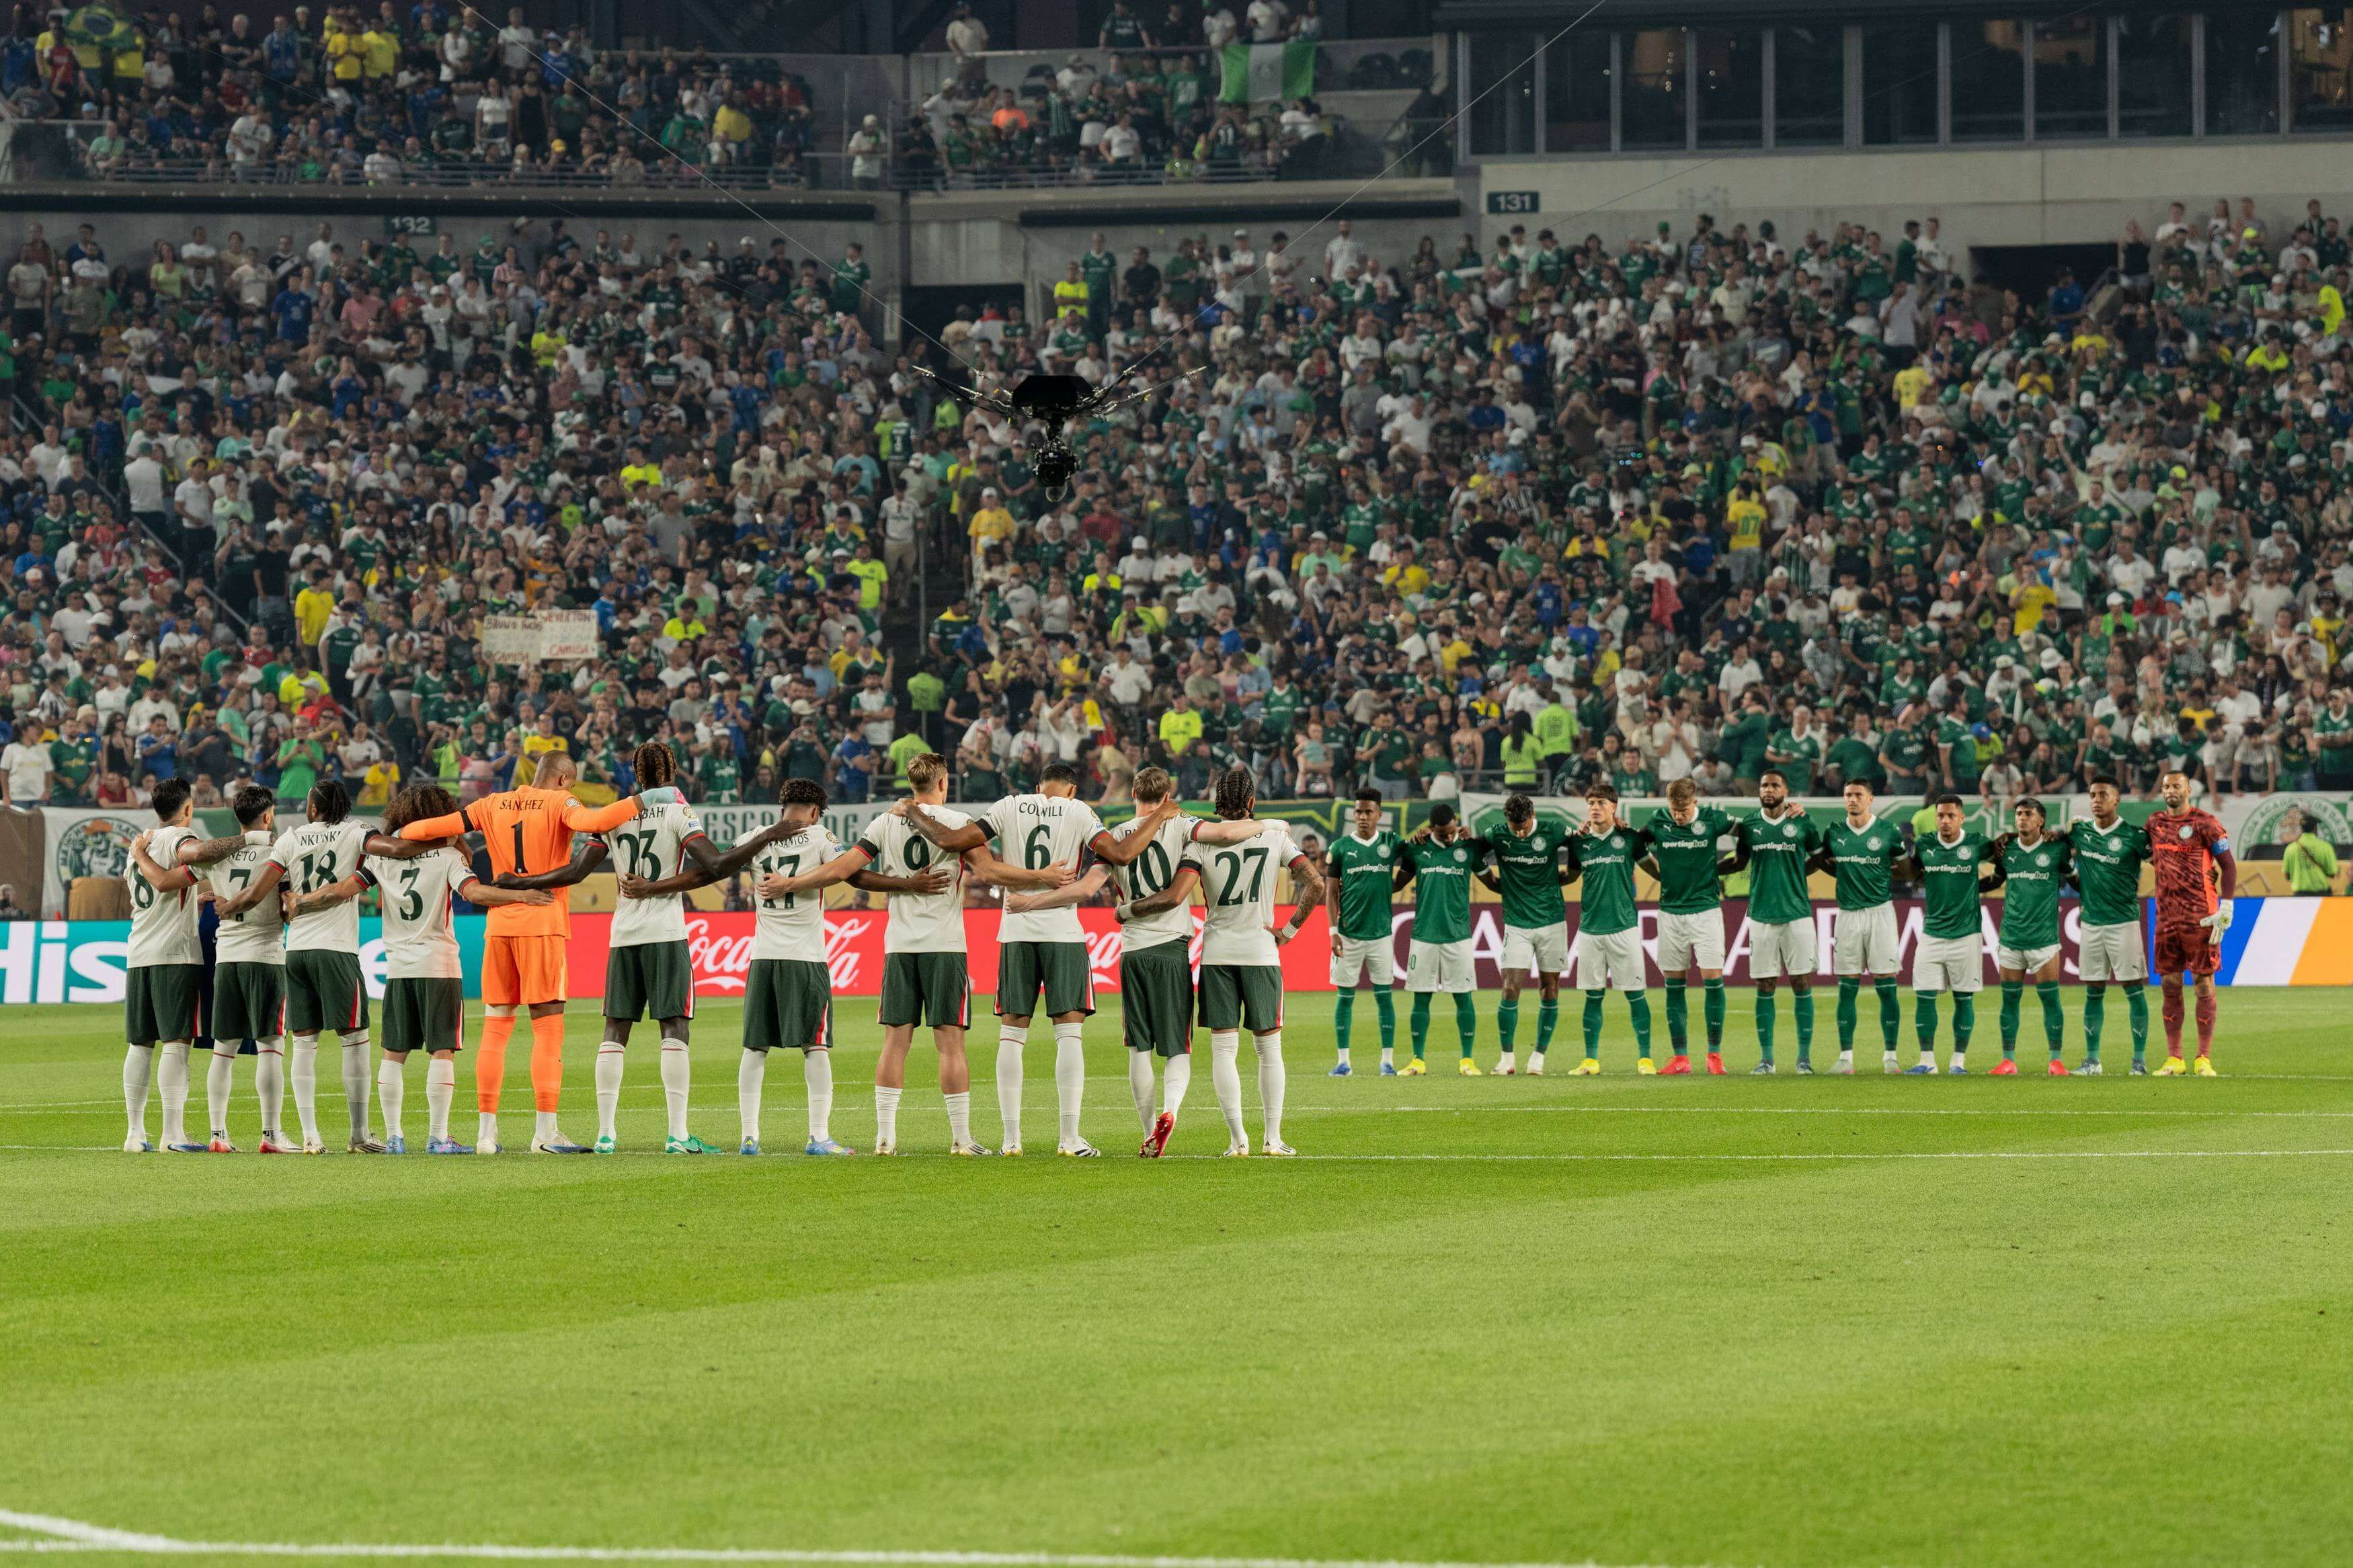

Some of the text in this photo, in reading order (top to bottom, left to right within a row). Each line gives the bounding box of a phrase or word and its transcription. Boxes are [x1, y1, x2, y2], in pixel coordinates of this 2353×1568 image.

[391, 216, 430, 233] 132
[1496, 194, 1531, 211] 131
[300, 850, 337, 895] 18
[511, 820, 528, 874] 1
[616, 829, 662, 882] 23
[1025, 824, 1051, 870] 6
[1128, 840, 1172, 901] 10
[1347, 863, 1390, 874] sportingbet
[1421, 865, 1464, 876] sportingbet
[229, 868, 251, 921] 7
[399, 867, 424, 921] 3
[758, 854, 801, 909] 17
[1215, 847, 1269, 906] 27
